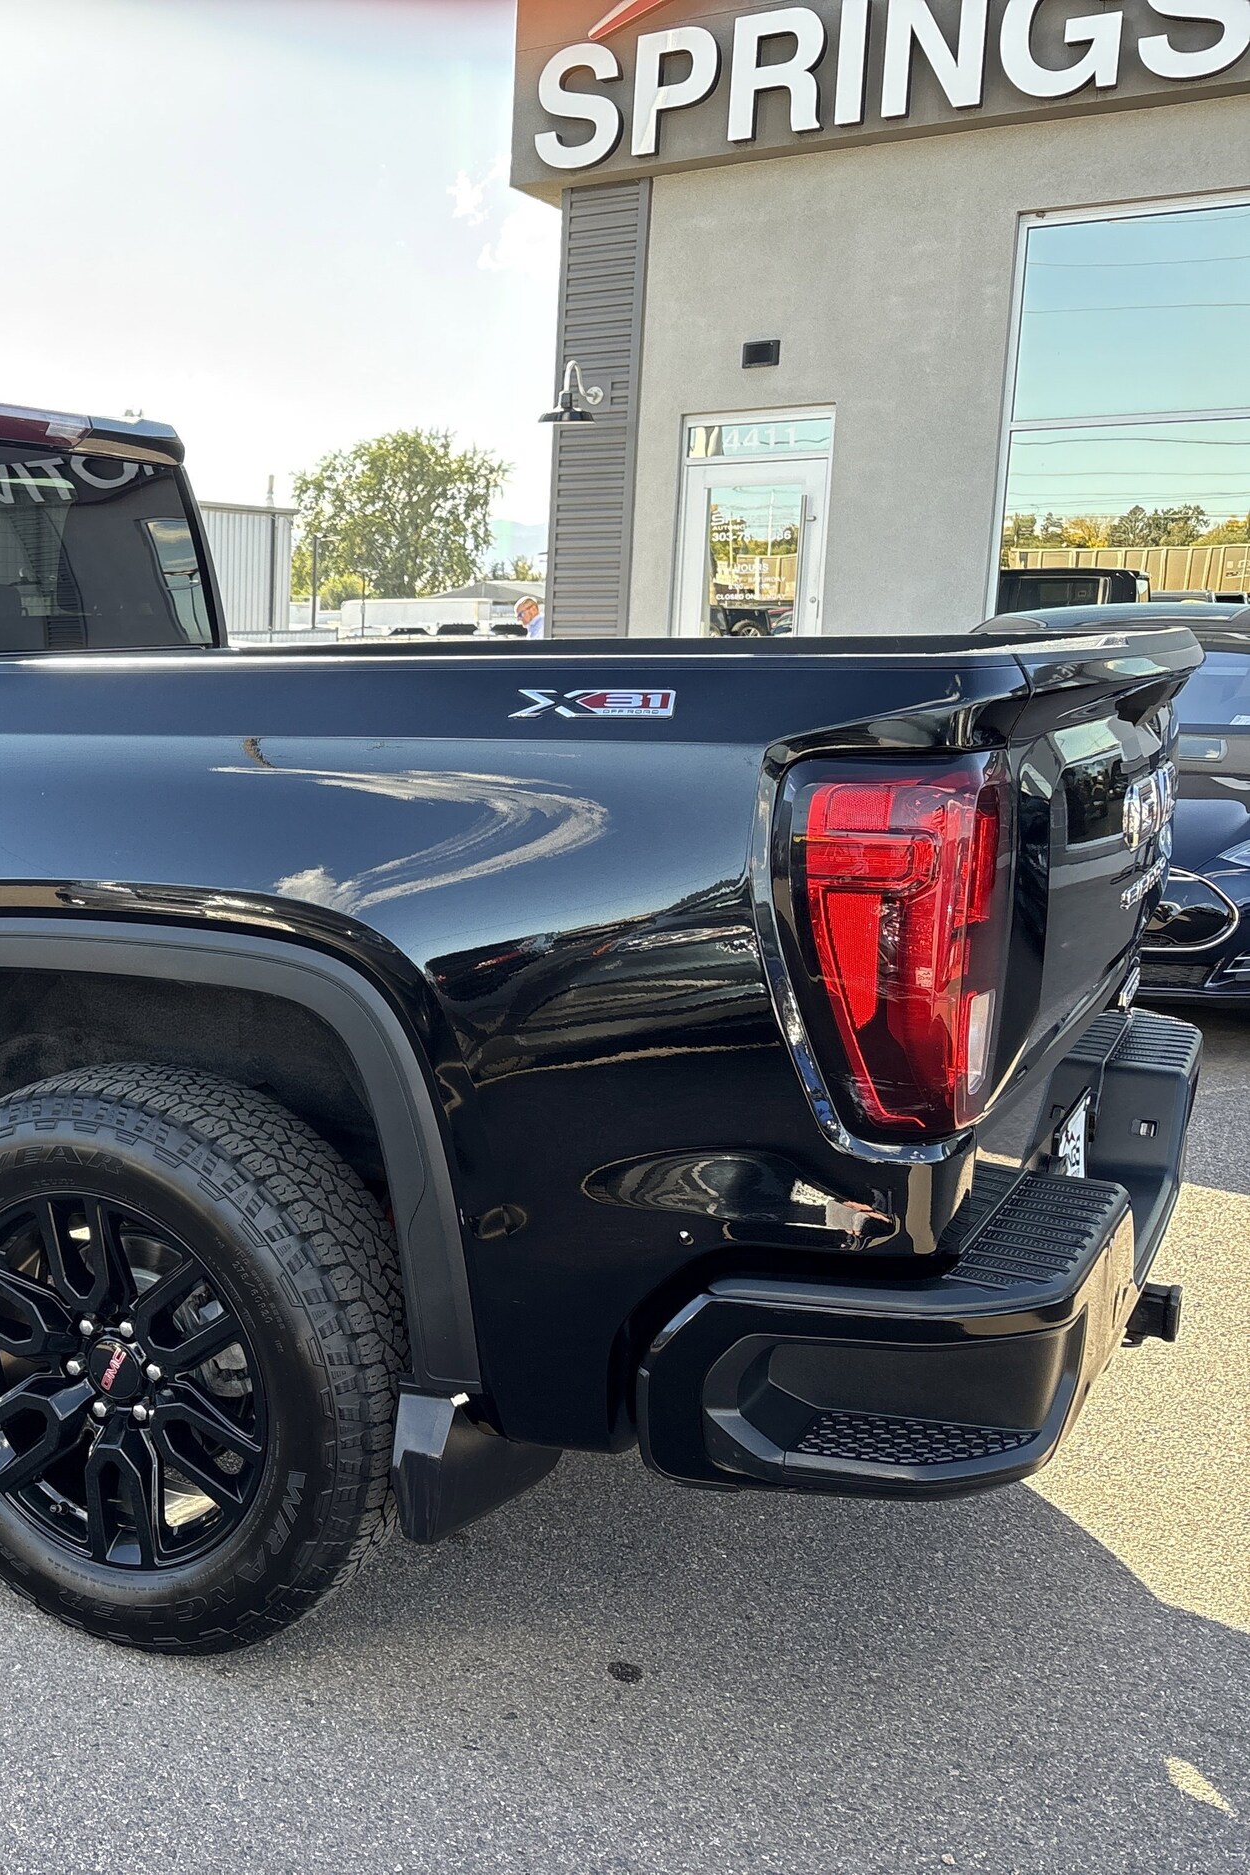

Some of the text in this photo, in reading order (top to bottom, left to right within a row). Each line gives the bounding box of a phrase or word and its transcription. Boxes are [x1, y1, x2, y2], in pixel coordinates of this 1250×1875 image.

[533, 0, 1250, 170] SPRINGS
[725, 425, 797, 450] 4411
[100, 1346, 127, 1391] GMC
